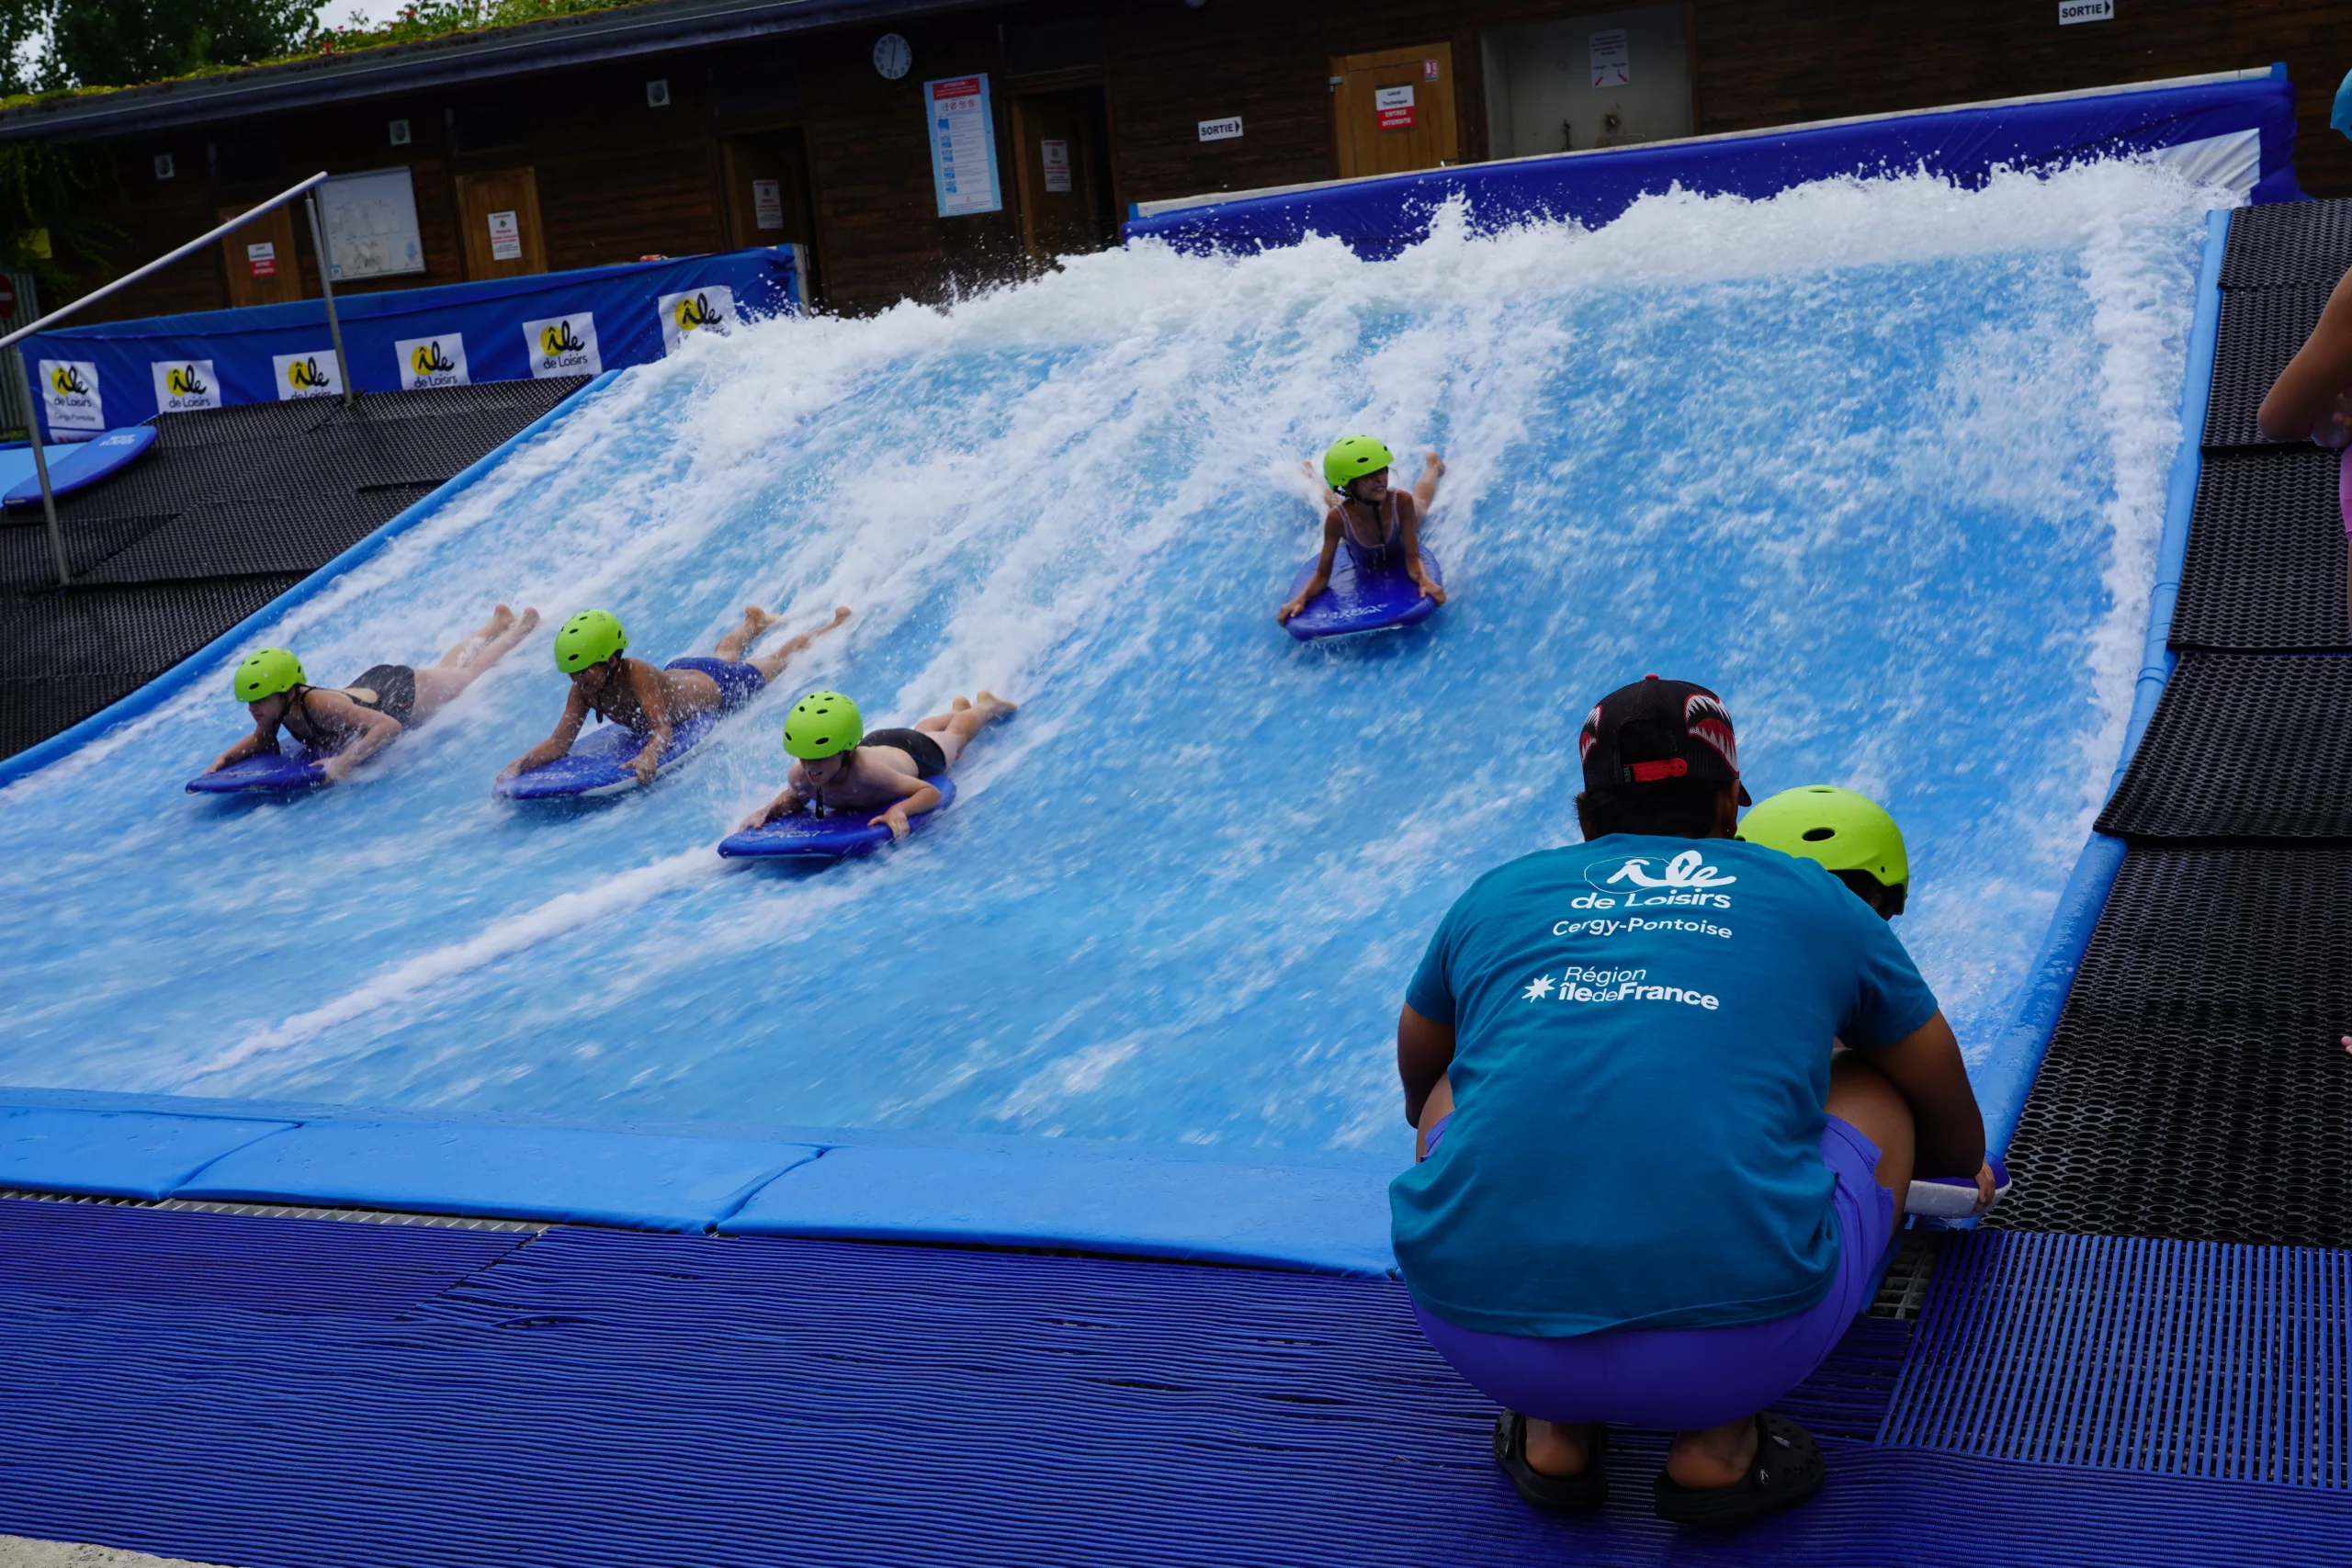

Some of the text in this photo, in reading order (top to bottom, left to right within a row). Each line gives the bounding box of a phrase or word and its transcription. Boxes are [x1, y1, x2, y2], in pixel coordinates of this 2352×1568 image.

[2062, 4, 2102, 18] SORTIE
[1201, 123, 1234, 136] SORTIE
[543, 354, 588, 369] de Loisirs
[414, 373, 458, 388] de Loisirs
[54, 396, 92, 407] de Loisirs
[169, 396, 211, 408] de Loisirs
[1607, 850, 1736, 887] île
[1571, 888, 1732, 909] de Loisirs
[1553, 917, 1733, 939] Cergy-Pontoise
[1564, 966, 1646, 987] Région
